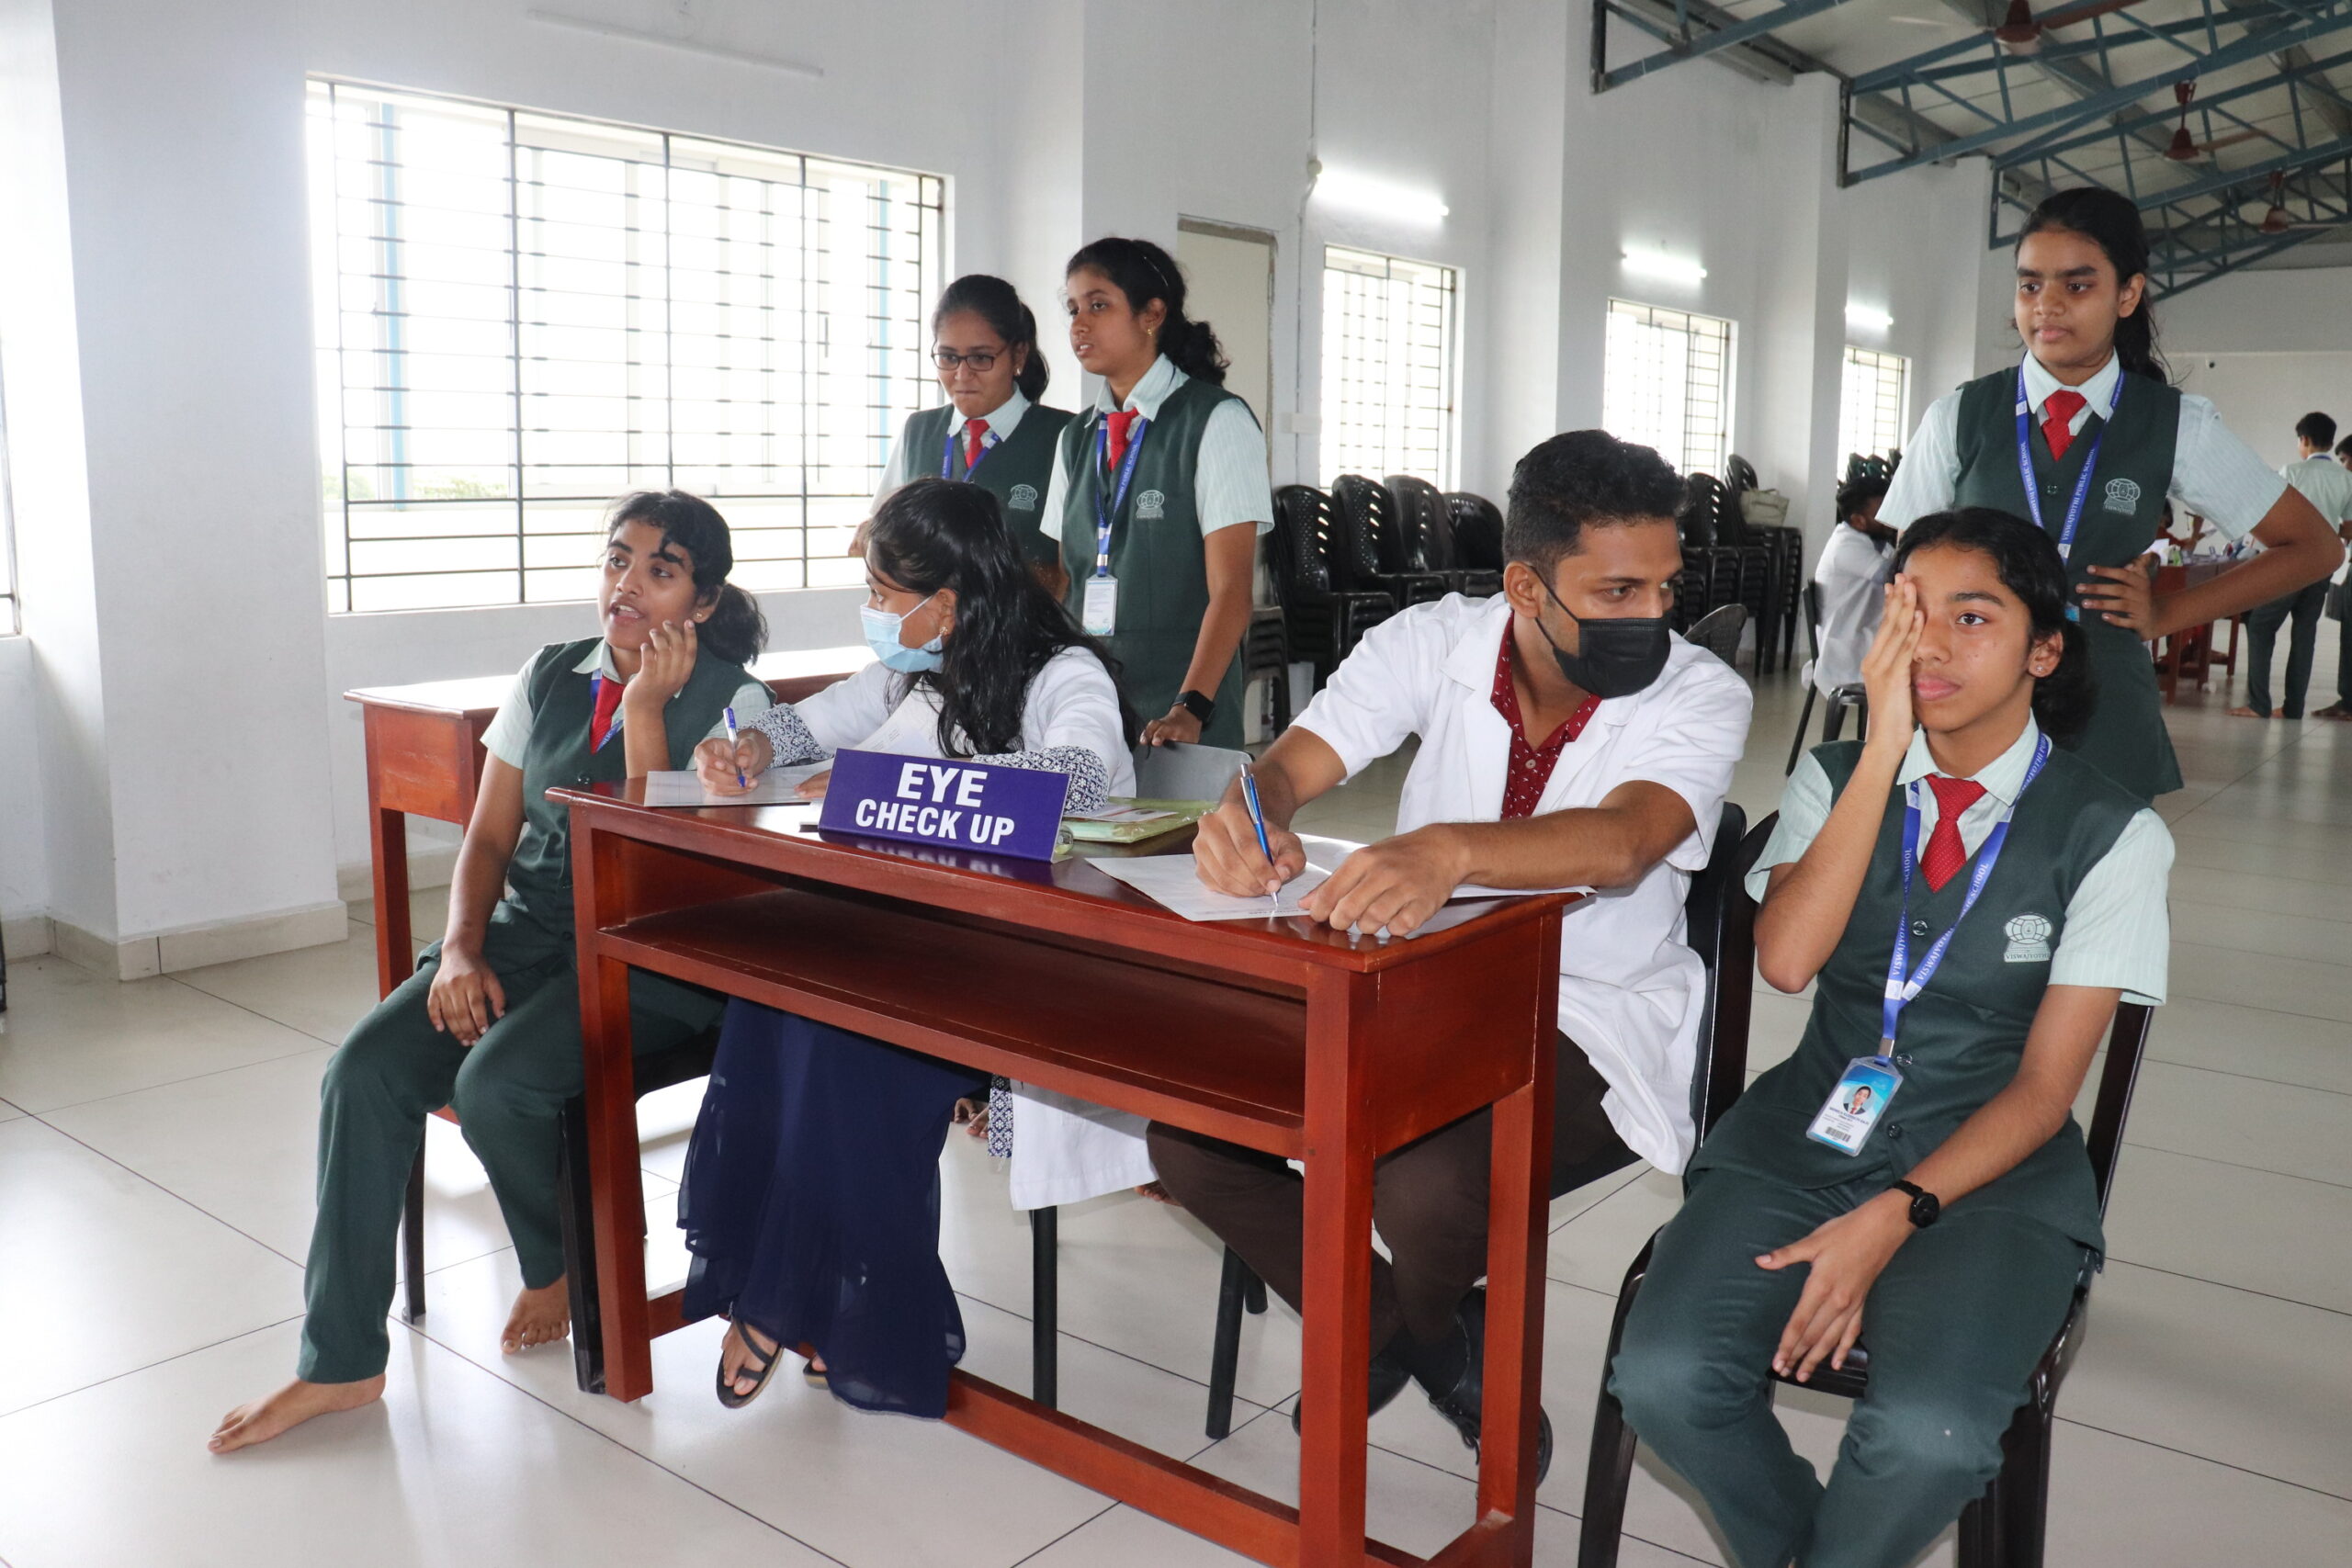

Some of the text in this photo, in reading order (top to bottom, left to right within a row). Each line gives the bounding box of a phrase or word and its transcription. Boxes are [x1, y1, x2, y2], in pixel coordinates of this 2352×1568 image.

[2075, 472, 2088, 497] PUBLIC
[896, 761, 989, 808] EYE
[854, 797, 1015, 846] CHECK UP
[1970, 863, 1989, 898] SCHOOL
